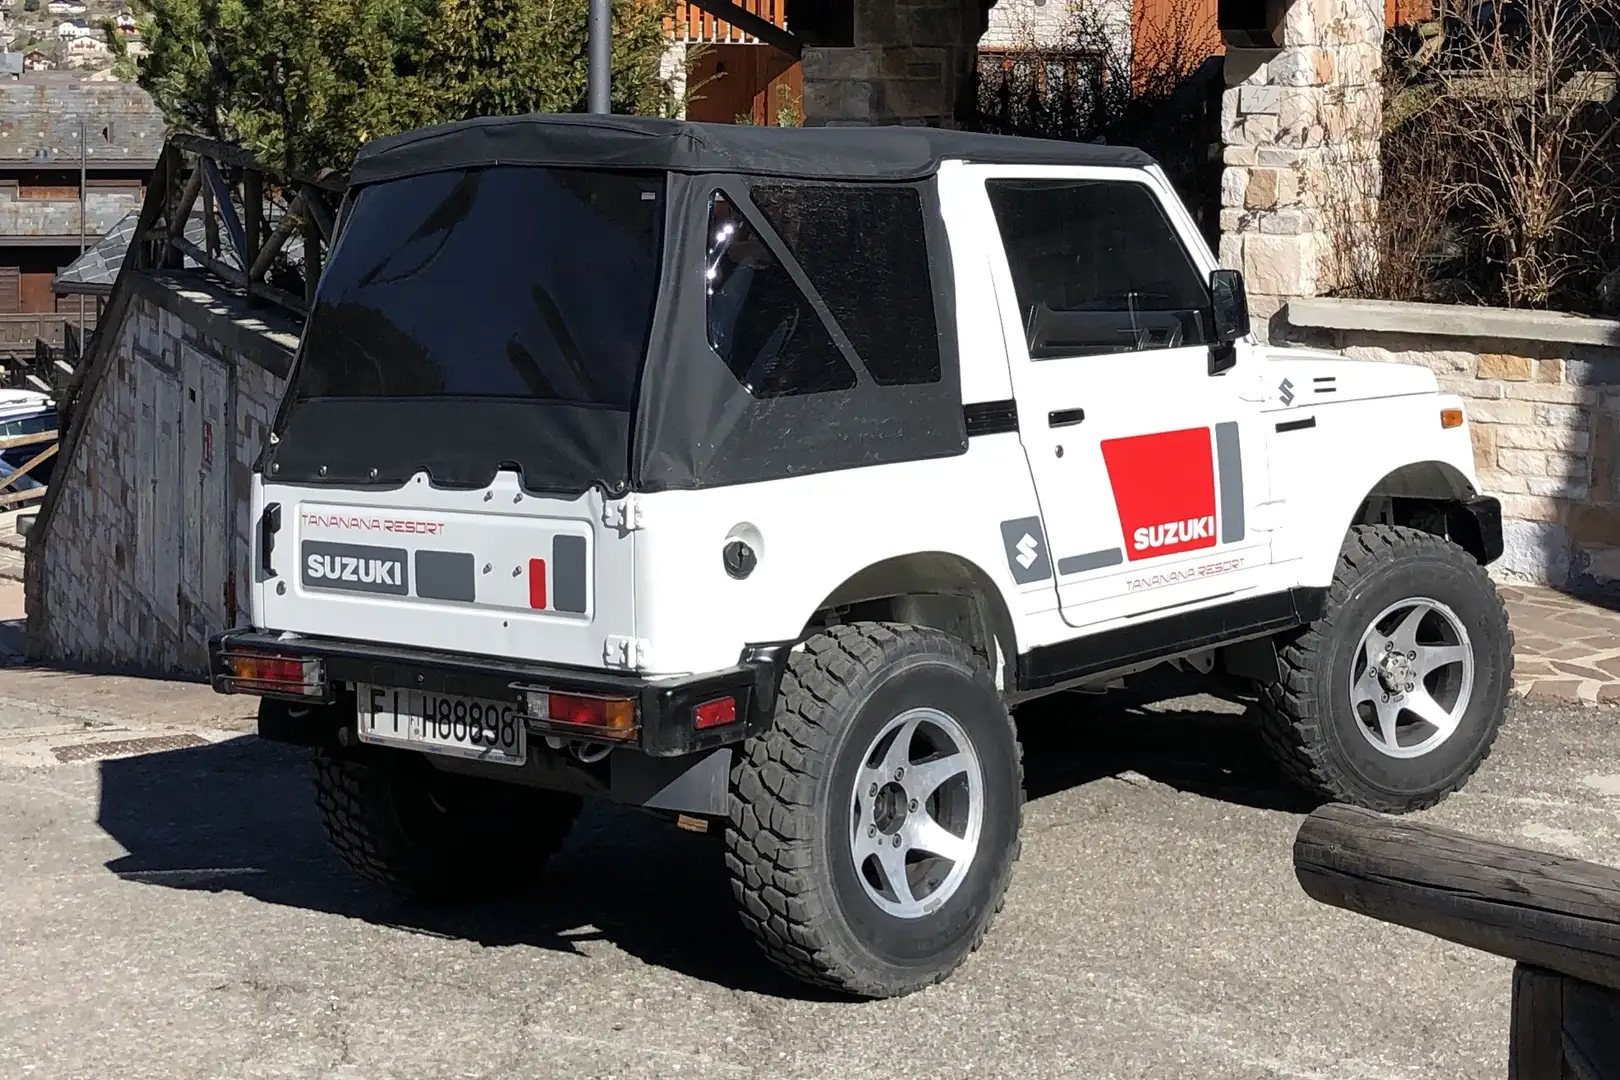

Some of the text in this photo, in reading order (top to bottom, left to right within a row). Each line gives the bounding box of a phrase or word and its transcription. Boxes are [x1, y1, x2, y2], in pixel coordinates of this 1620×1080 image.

[1251, 88, 1270, 103] 47
[301, 514, 445, 535] TANANANA RESORT
[1133, 515, 1215, 551] SUZUKI
[307, 553, 402, 586] SUZUKI
[1126, 557, 1244, 591] TANANANA RESORT
[422, 695, 515, 748] H88898
